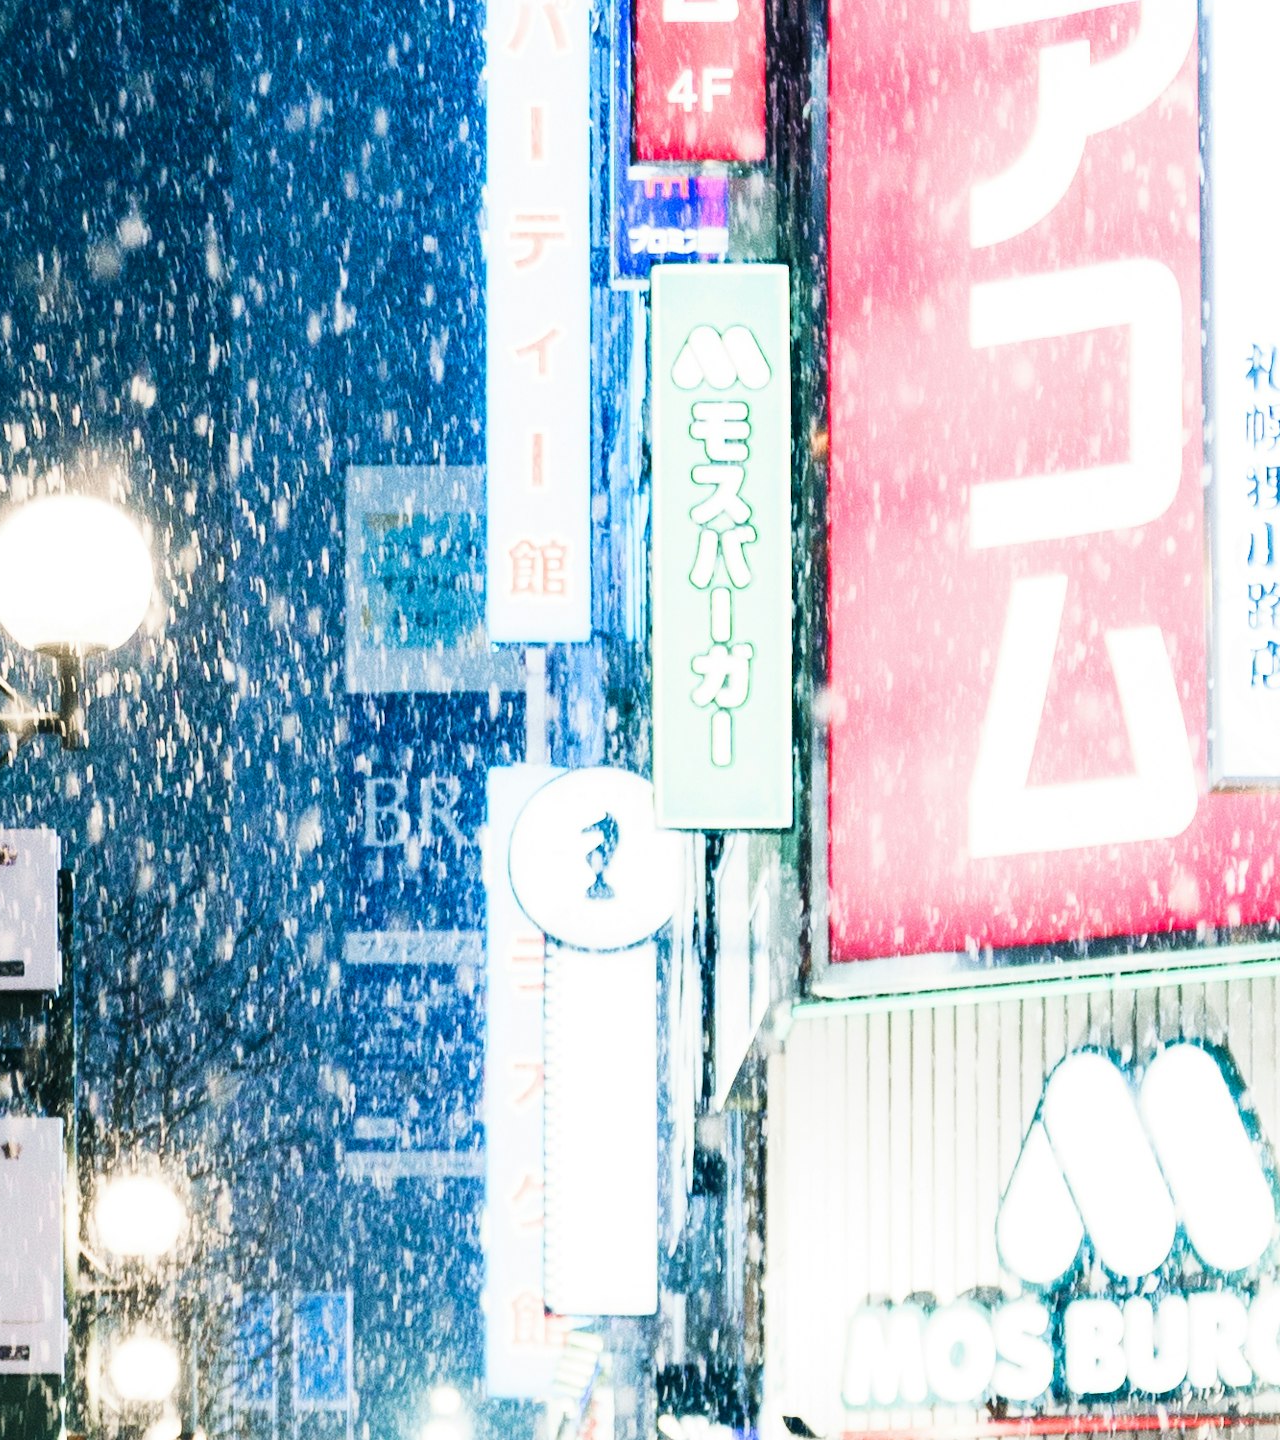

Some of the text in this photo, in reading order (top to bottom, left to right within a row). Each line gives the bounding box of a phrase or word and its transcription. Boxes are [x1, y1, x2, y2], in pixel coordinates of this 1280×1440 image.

[667, 68, 734, 112] 4F
[689, 401, 757, 767] モスバーガー
[841, 1298, 1055, 1410] MOS
